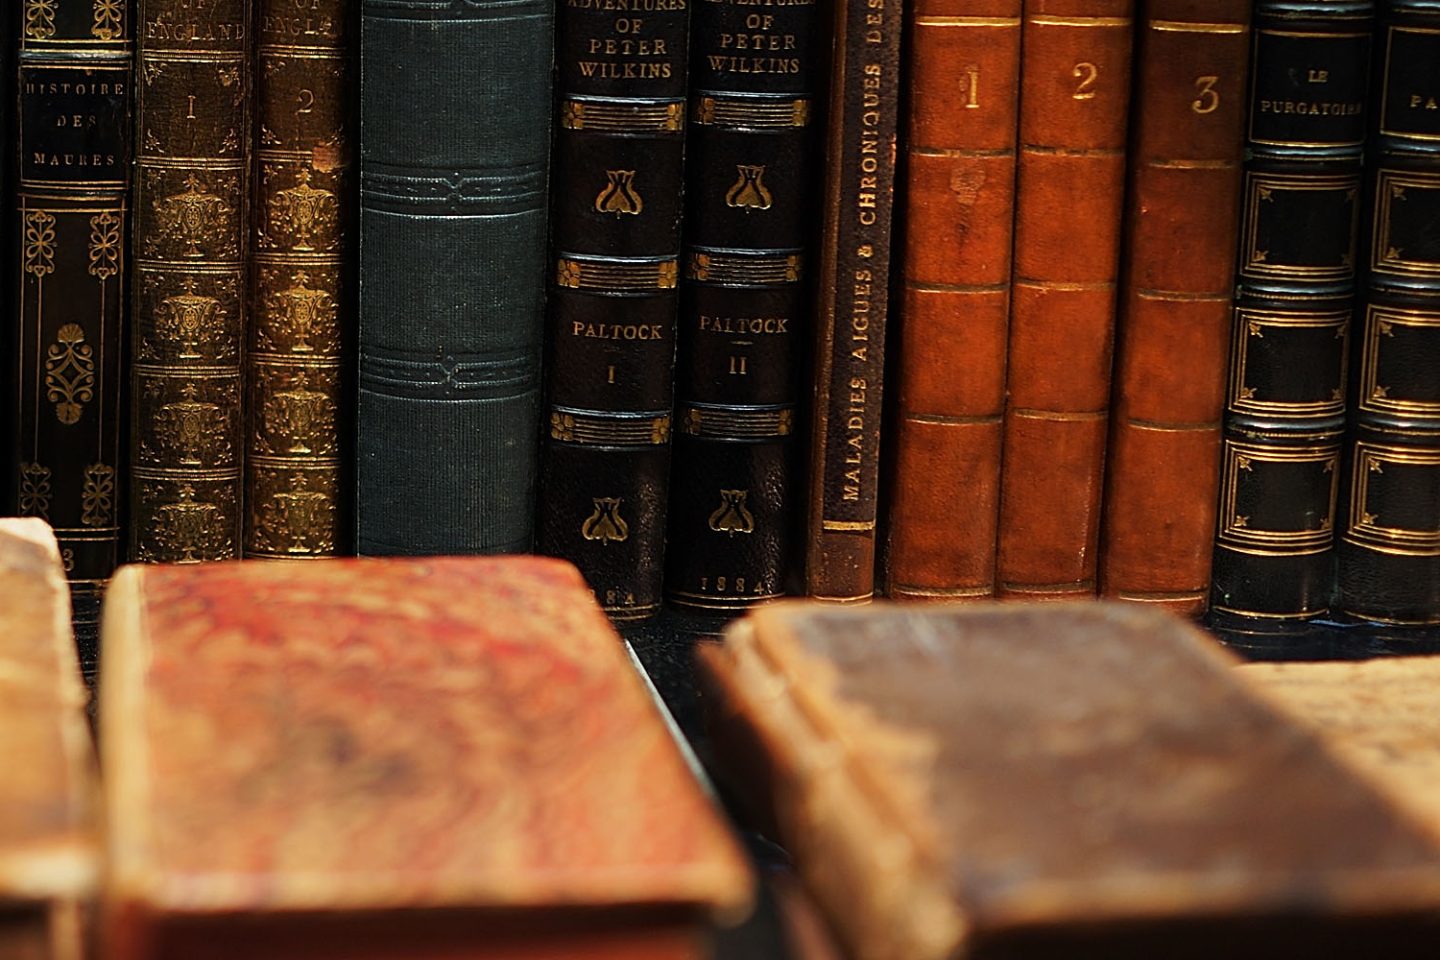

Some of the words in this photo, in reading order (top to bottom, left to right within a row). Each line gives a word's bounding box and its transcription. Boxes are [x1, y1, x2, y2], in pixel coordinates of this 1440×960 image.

[147, 20, 246, 41] ENGLAND
[615, 18, 644, 34] OF
[746, 14, 775, 30] OF
[590, 39, 667, 55] PETER
[720, 34, 796, 51] PETER
[578, 62, 672, 79] WILKINS
[707, 55, 800, 73] WILKINS
[1072, 62, 1098, 101] 2
[1308, 70, 1329, 82] LE
[26, 83, 124, 95] HISTOIRE
[964, 68, 980, 109] 1
[1192, 76, 1220, 114] 3
[296, 89, 315, 114] 2
[57, 115, 97, 127] DES
[859, 64, 882, 225] CHRONIQUES
[34, 152, 115, 166] MAURES
[858, 243, 874, 258] &
[852, 270, 872, 361] AIGUES
[573, 321, 663, 340] PALTOCK
[699, 316, 789, 334] PALTOCK
[607, 365, 616, 384] I
[728, 356, 748, 375] II
[843, 378, 867, 501] MALADIES
[701, 577, 765, 595] 1884
